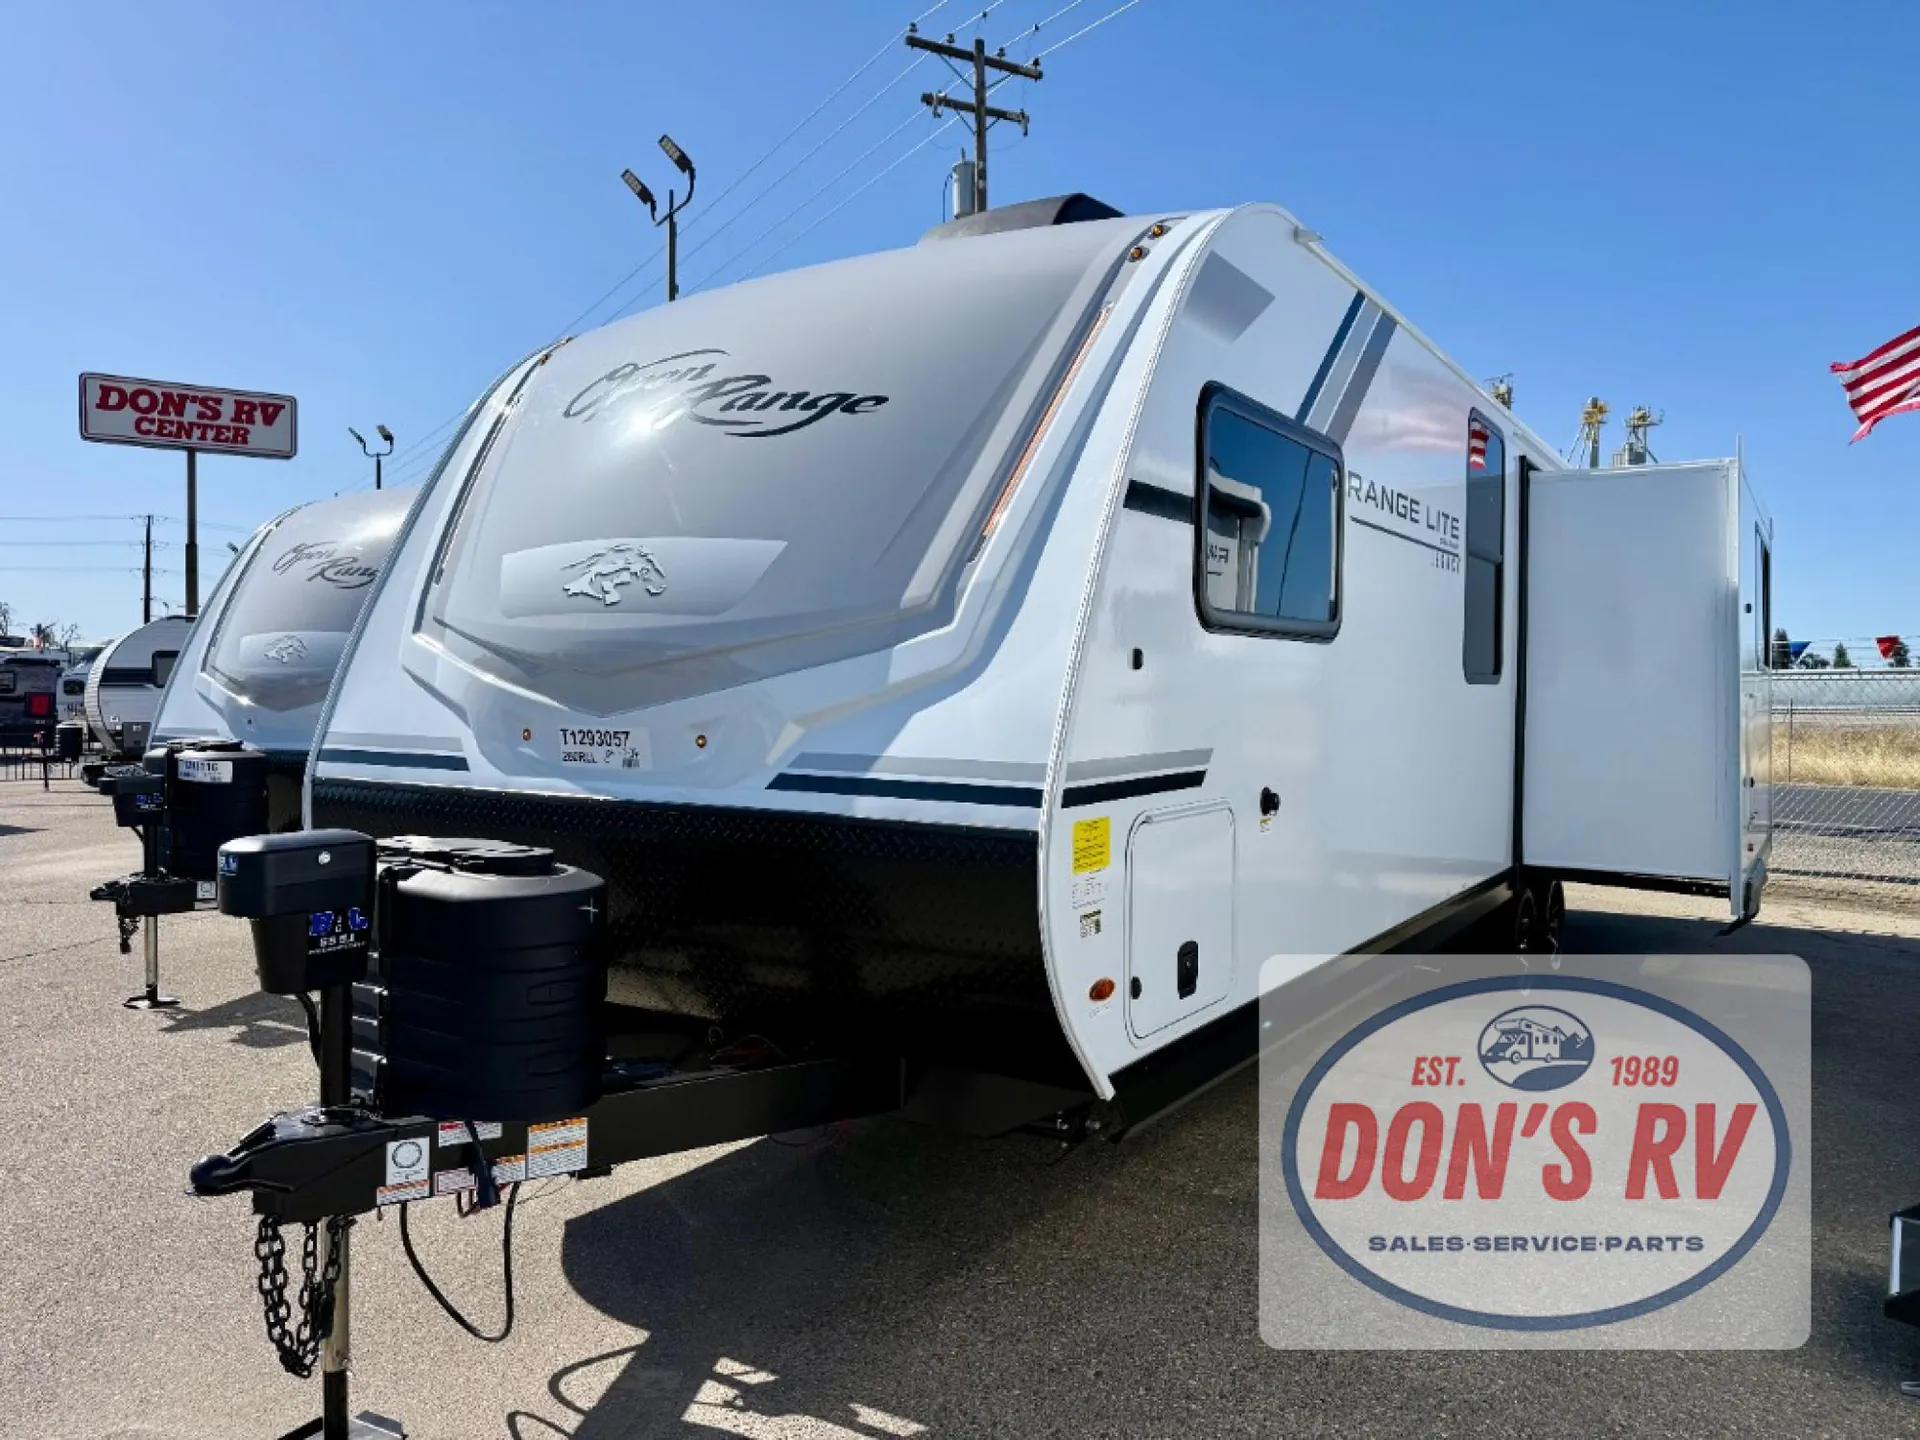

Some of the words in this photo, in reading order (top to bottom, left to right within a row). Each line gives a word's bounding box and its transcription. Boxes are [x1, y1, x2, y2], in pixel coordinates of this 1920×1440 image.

[95, 384, 223, 421] DON'S
[230, 399, 286, 426] RV
[651, 374, 890, 437] Range
[134, 416, 251, 445] CENTER
[1347, 470, 1421, 524] RANGE
[1426, 505, 1460, 540] LITE
[306, 557, 380, 589] Rang
[560, 729, 630, 747] T1293057
